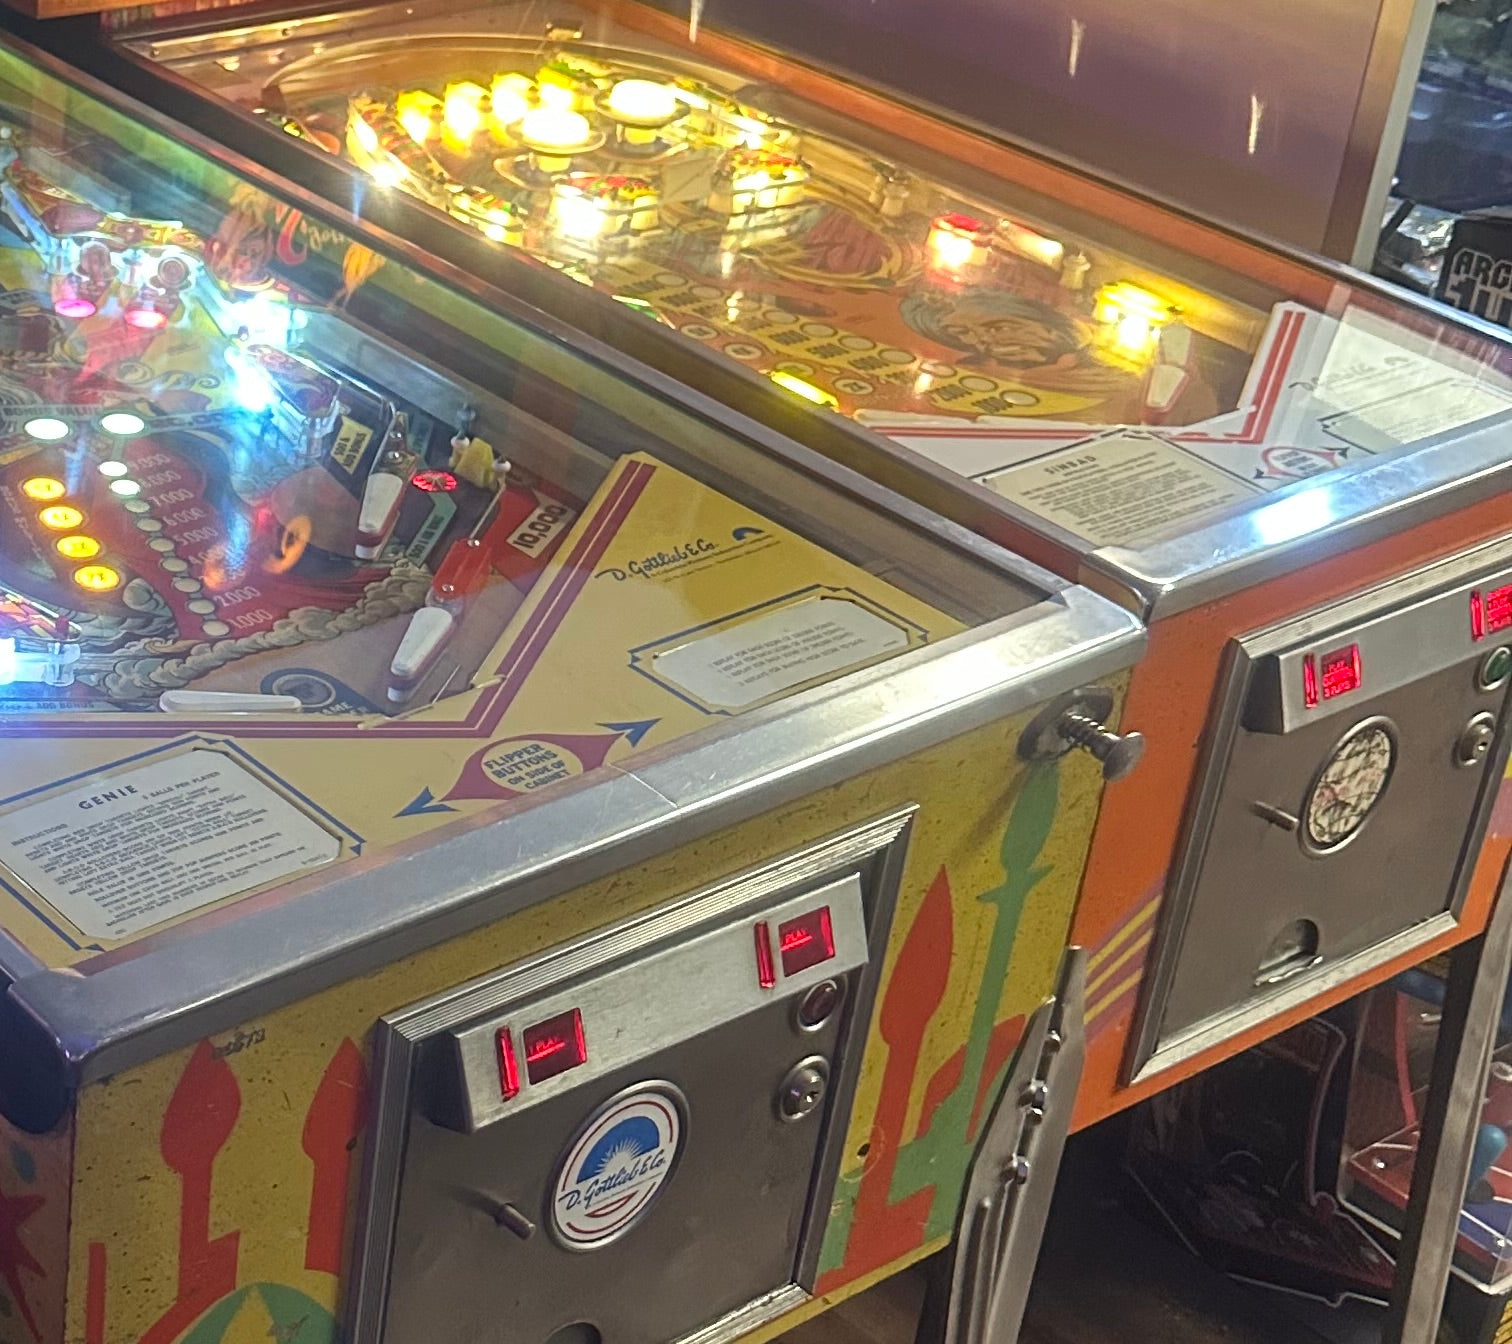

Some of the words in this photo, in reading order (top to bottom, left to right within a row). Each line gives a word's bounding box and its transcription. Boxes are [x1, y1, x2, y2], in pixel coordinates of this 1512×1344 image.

[1044, 455, 1097, 475] SINBAD
[512, 504, 569, 550] 10,000
[628, 545, 688, 579] Gottlieb
[483, 743, 545, 769] FLIPPER
[491, 750, 558, 778] BUTTONS
[507, 775, 525, 785] ON
[524, 765, 550, 779] SIDE
[550, 759, 565, 769] OF
[524, 769, 571, 789] CABINET
[78, 783, 140, 810] GENIE
[558, 1190, 581, 1211] D.
[584, 1166, 639, 1210] Gottlieb
